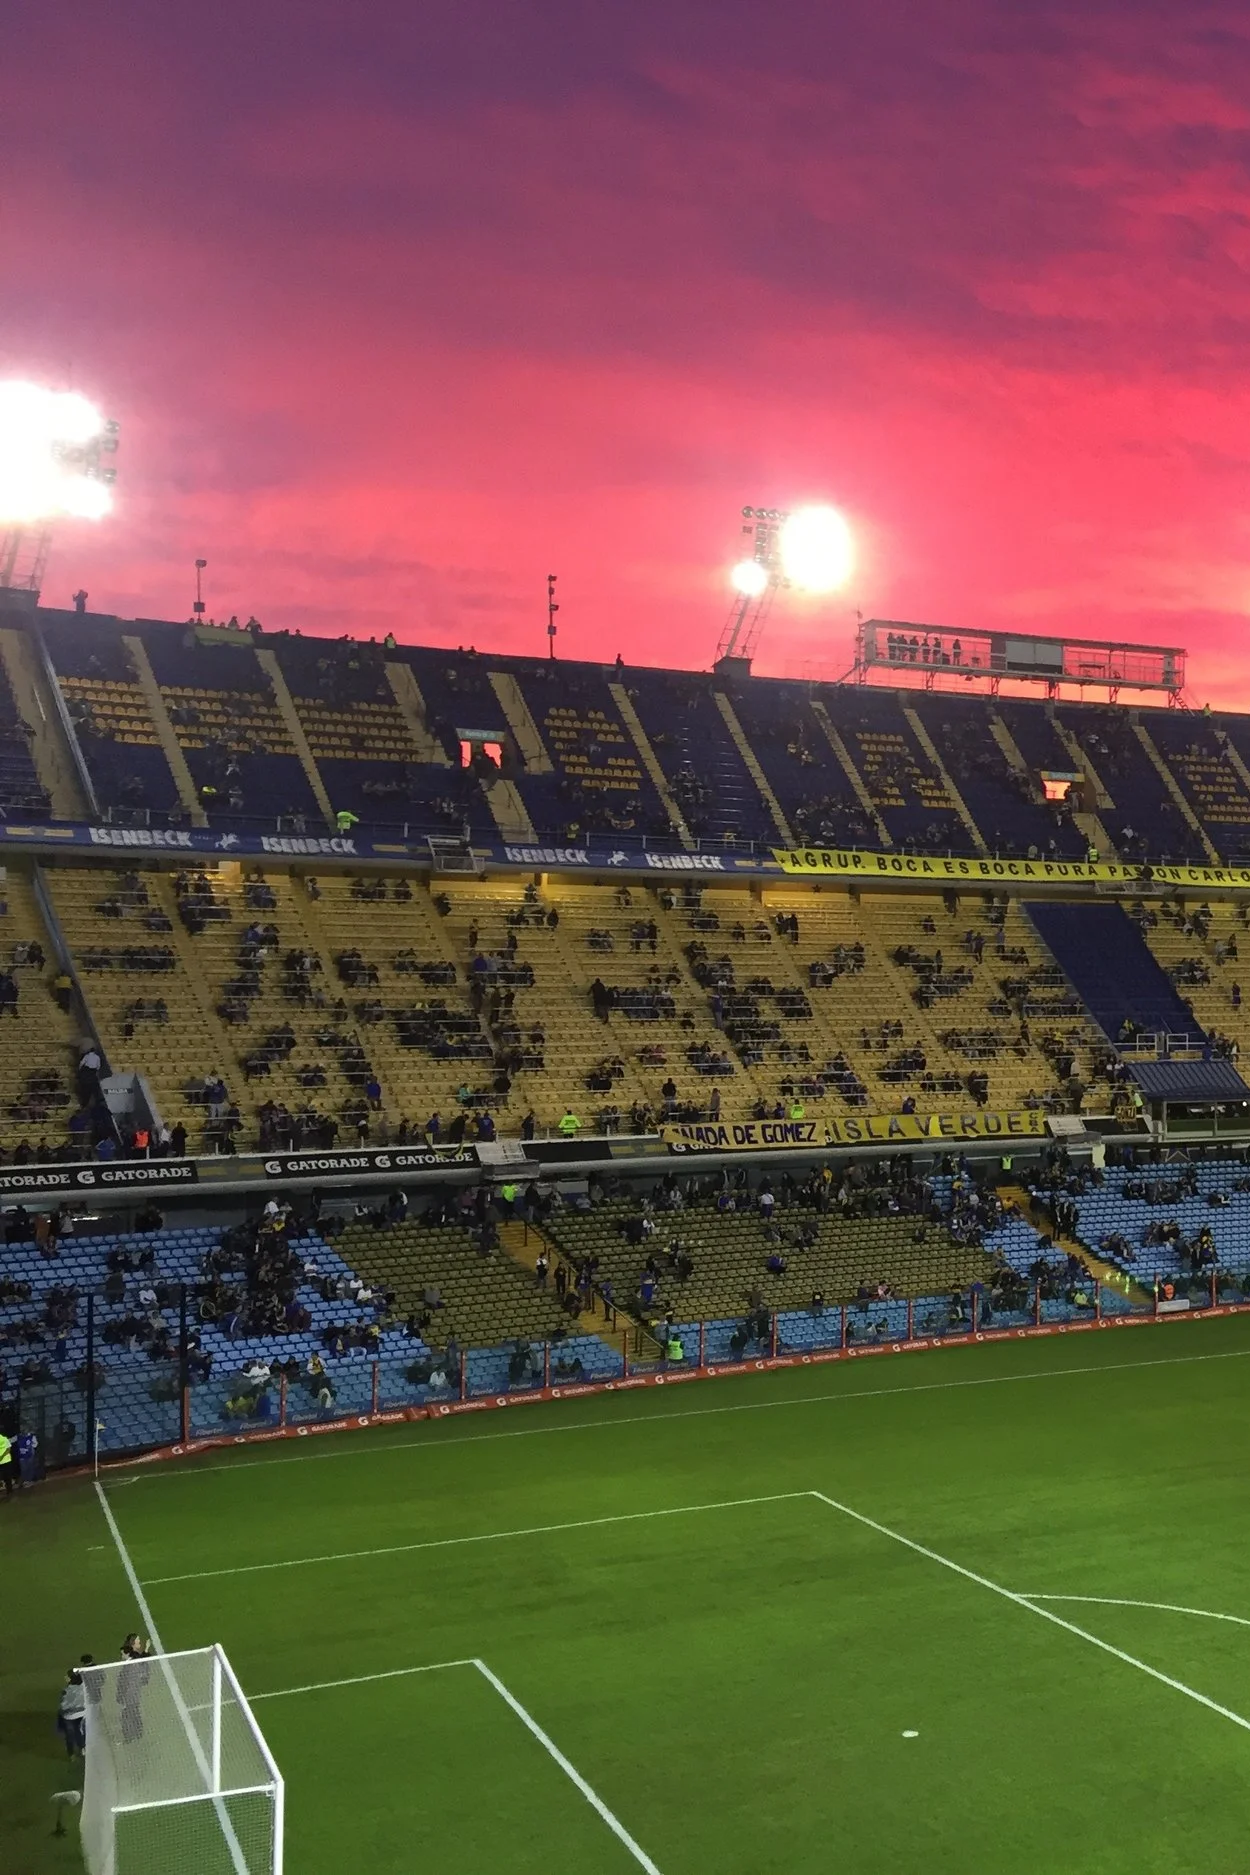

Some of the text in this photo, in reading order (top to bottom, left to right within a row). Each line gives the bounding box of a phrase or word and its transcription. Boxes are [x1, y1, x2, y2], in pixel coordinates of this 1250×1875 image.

[89, 828, 192, 846] ISENBECK
[261, 836, 358, 855] ISENBECK
[504, 847, 590, 864] ISENBECK
[645, 853, 725, 870] ISENBECK
[791, 851, 866, 869] AGRUP.
[877, 857, 934, 873] BOCA
[944, 861, 969, 874] ES
[979, 862, 1036, 876] BOCA
[1045, 863, 1098, 876] PURA
[1108, 865, 1181, 881] PASON
[732, 1125, 758, 1145] DE
[761, 1122, 817, 1143] GOMEZ
[831, 1112, 1022, 1141] ISLA VERDE
[287, 1157, 370, 1171] GATORADE
[0, 1174, 70, 1187] TORADE
[101, 1167, 192, 1181] GATORADE
